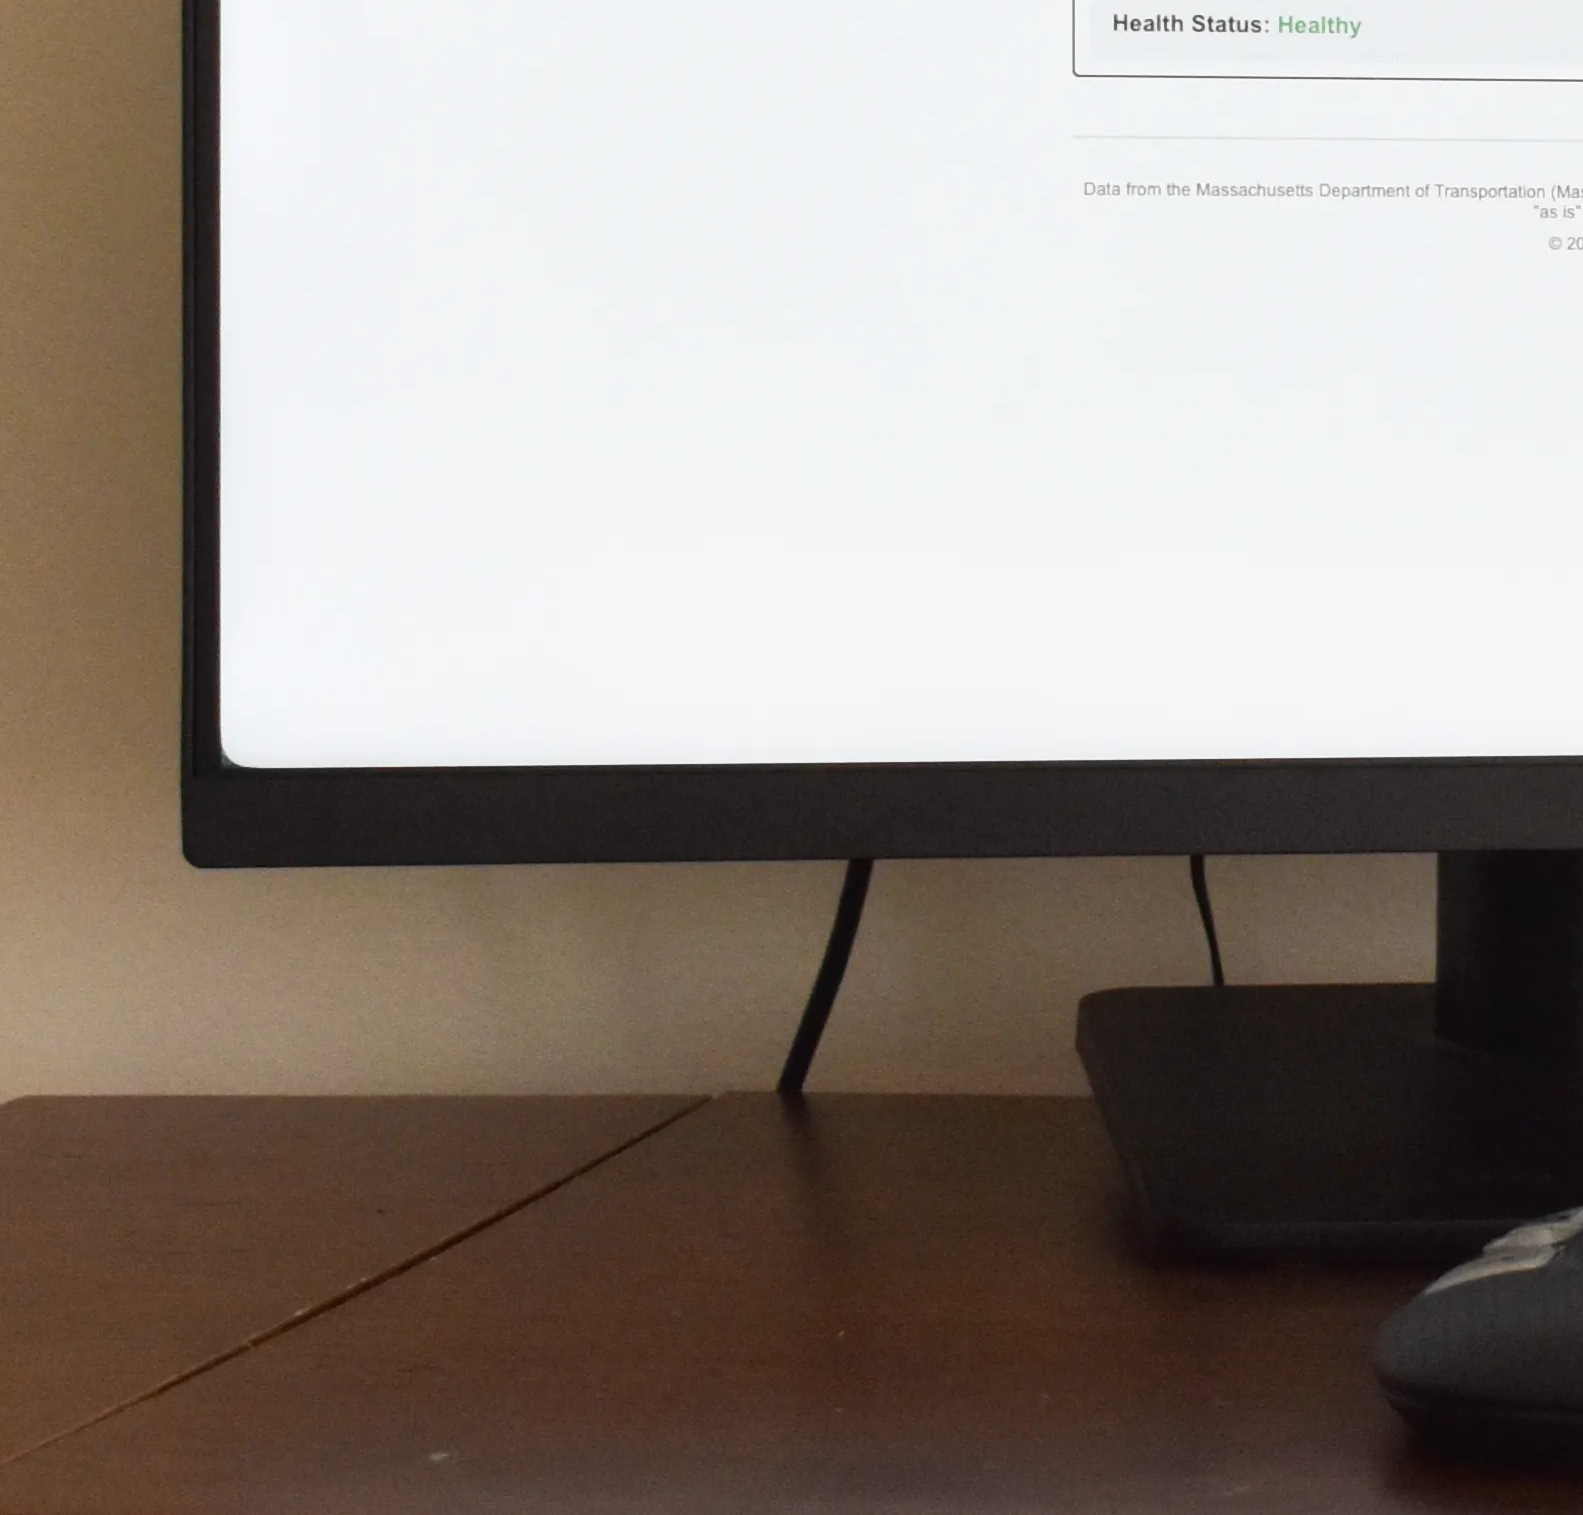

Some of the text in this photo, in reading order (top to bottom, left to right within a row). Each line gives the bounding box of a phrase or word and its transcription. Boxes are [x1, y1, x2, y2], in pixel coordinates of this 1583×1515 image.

[1113, 13, 1362, 39] Health Status: Healthy
[1083, 181, 1121, 197] Data
[1125, 181, 1162, 197] from
[1166, 183, 1191, 197] the
[1196, 182, 1314, 198] Massachusetts
[1319, 182, 1411, 201] Department
[1414, 183, 1430, 199] of
[1434, 183, 1546, 201] Transportation
